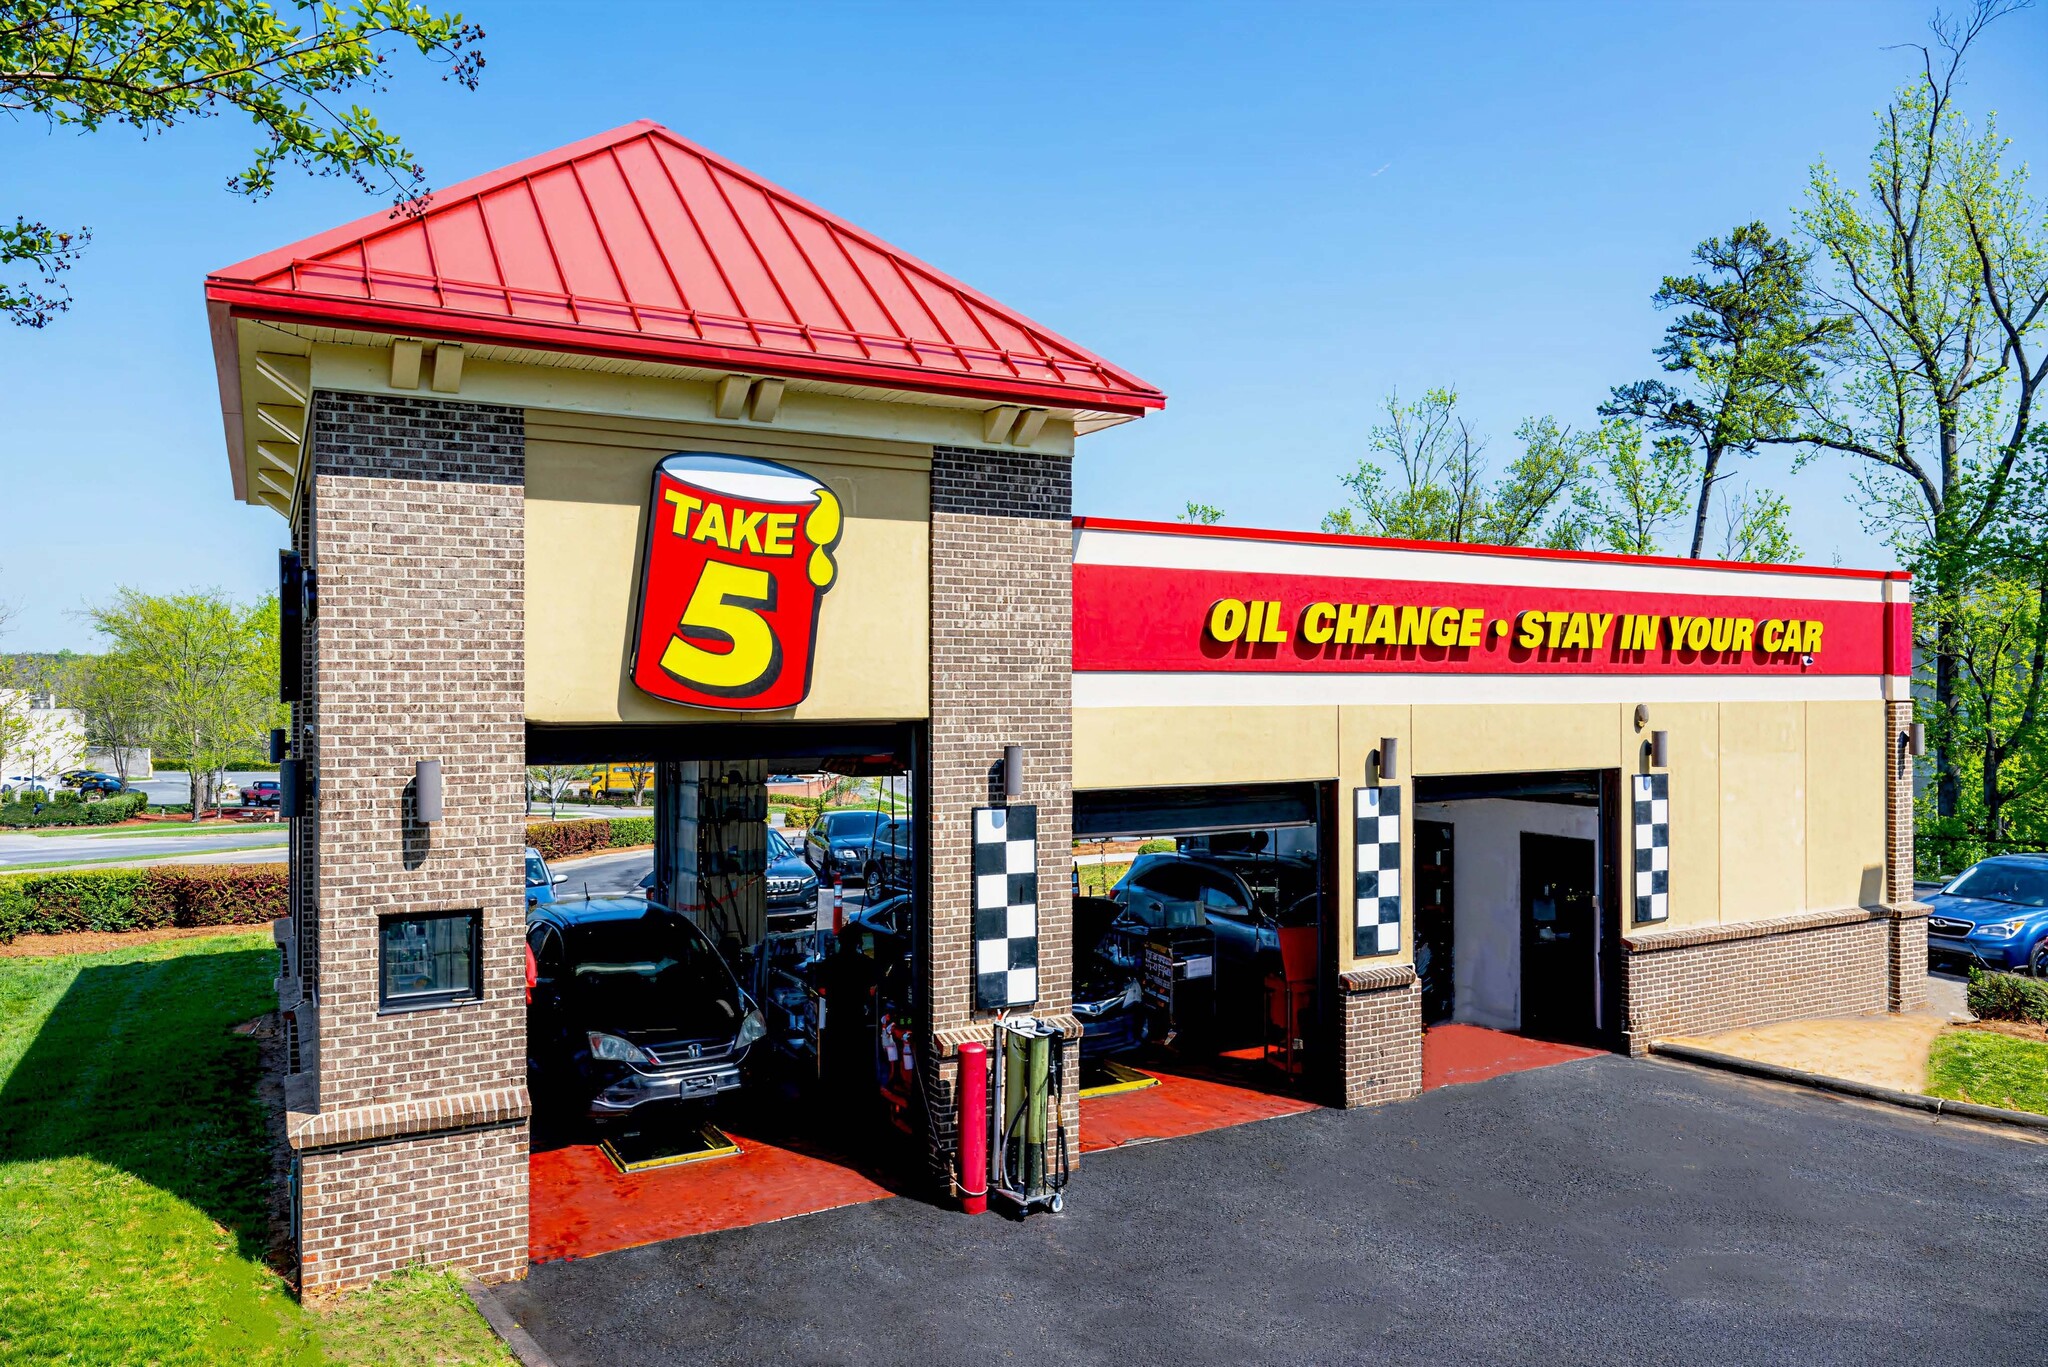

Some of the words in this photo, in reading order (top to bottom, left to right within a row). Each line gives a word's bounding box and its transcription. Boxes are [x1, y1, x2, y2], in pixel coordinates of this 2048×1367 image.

[664, 488, 798, 556] TAKE
[659, 559, 776, 690] 5
[1210, 598, 1288, 643] OIL
[1303, 601, 1485, 647] CHANGE
[1519, 610, 1614, 649] STAY
[1619, 614, 1661, 650] IN
[1669, 615, 1755, 653] YOUR
[1762, 618, 1825, 653] CAR
